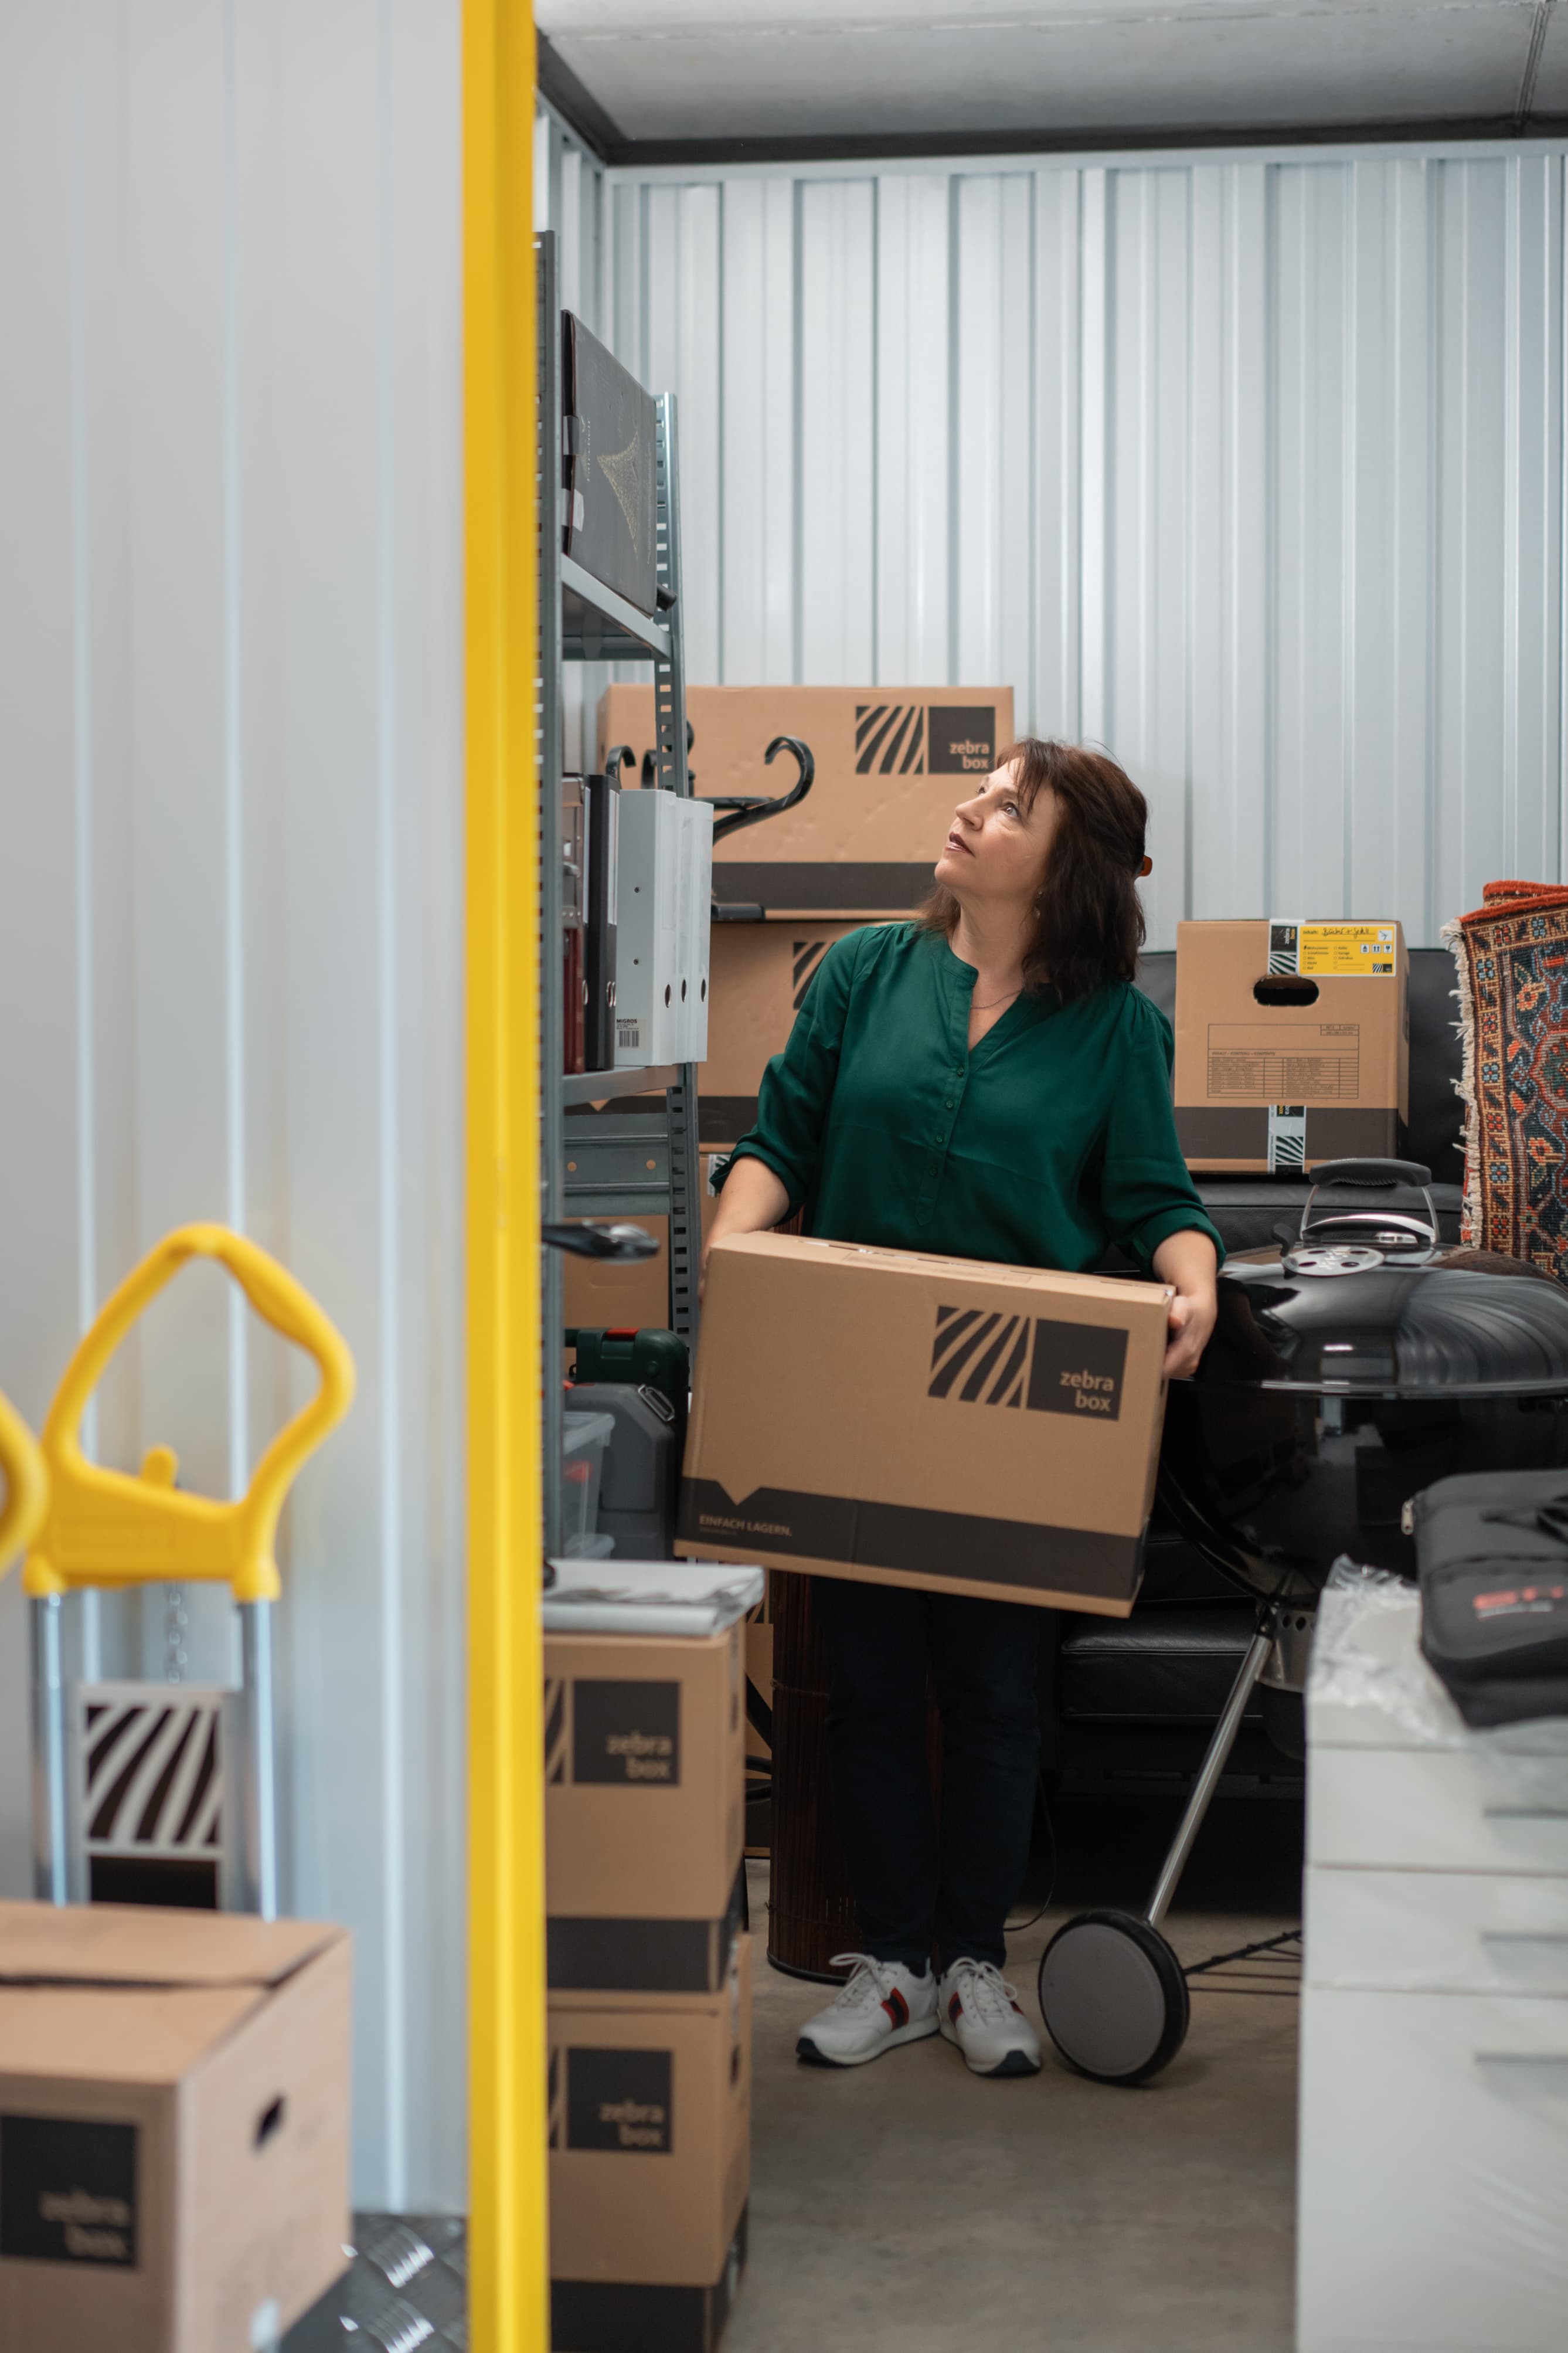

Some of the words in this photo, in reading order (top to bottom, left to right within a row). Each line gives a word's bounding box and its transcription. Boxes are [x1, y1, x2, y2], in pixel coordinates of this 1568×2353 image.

[949, 739, 989, 755] zebra
[962, 754, 989, 769] box
[1059, 1369, 1114, 1392] zebra
[1074, 1388, 1111, 1413] box
[699, 1514, 745, 1530] EINFACH
[747, 1521, 792, 1537] LAGERN.
[606, 1731, 672, 1756] zebra
[625, 1755, 670, 1780] box
